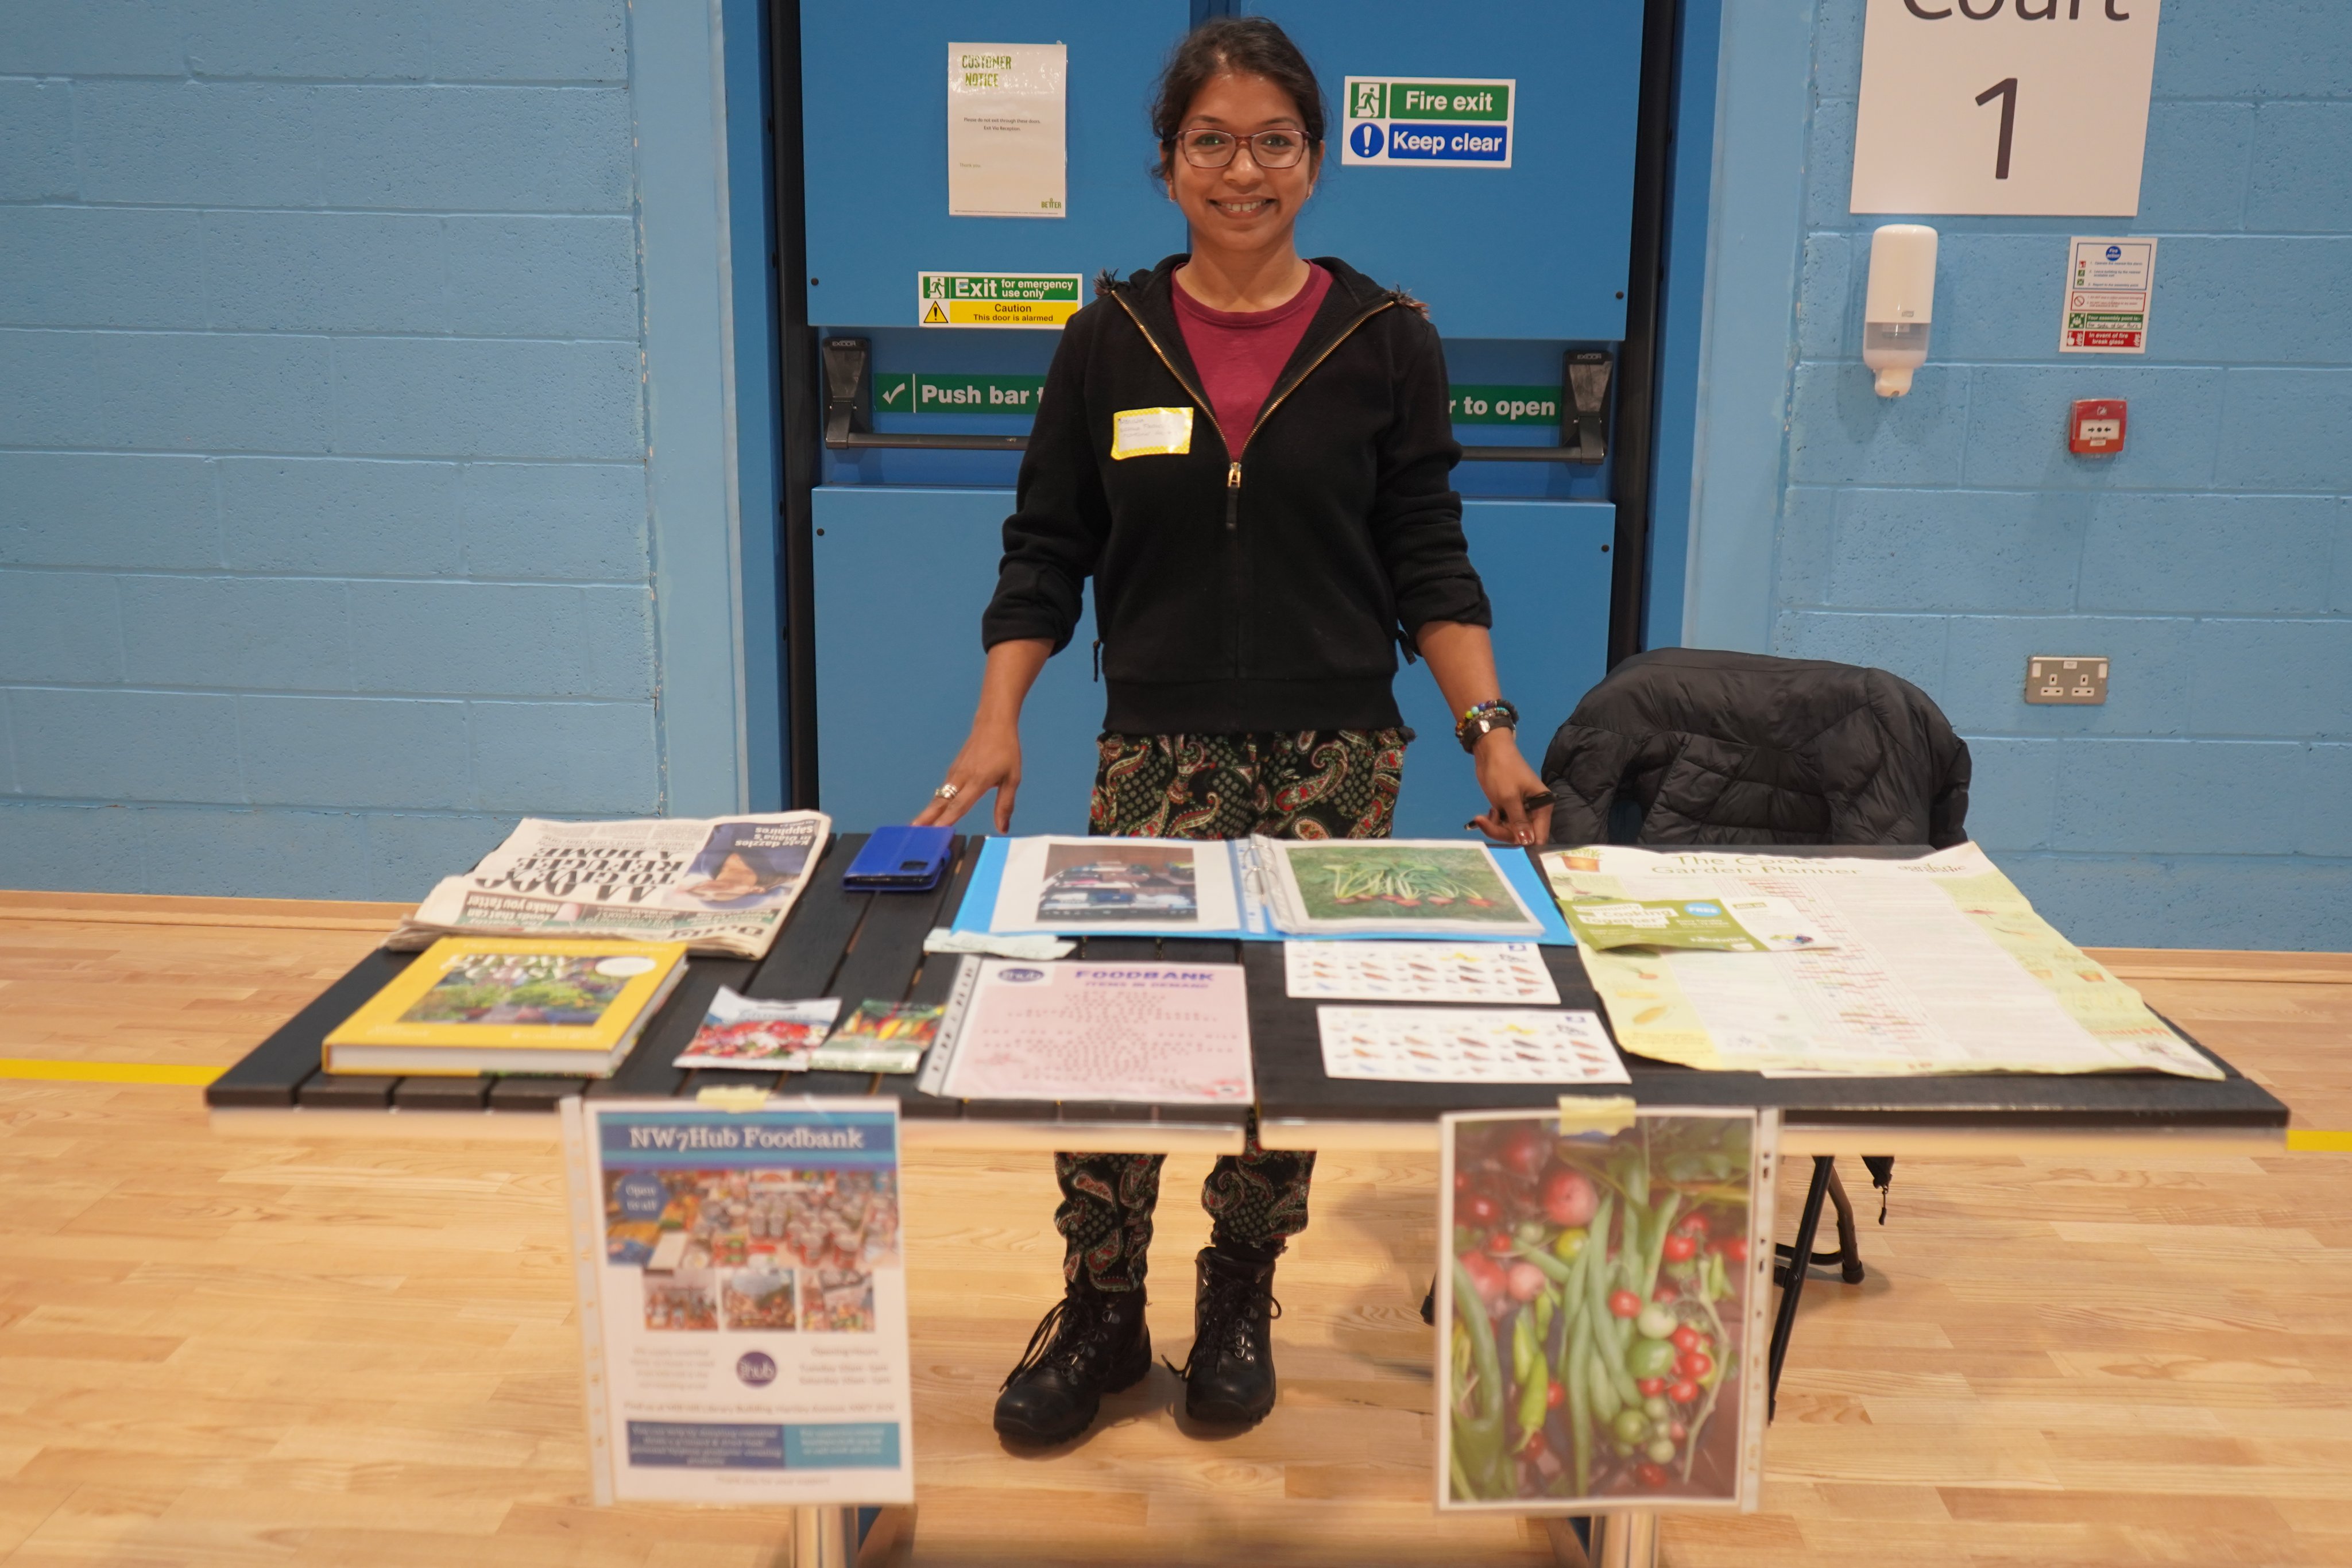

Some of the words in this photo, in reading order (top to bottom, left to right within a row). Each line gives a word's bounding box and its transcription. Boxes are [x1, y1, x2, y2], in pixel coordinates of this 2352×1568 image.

[962, 55, 1012, 69] CUSTOMER
[965, 73, 999, 87] NOTICE
[1406, 91, 1448, 110] Fire
[1453, 92, 1493, 111] exit
[1975, 78, 2018, 179] 1
[1394, 131, 1445, 155] Keep
[1451, 133, 1503, 152] clear
[956, 278, 997, 297] Exit
[1001, 279, 1015, 287] for
[1018, 281, 1073, 291] emergency
[1023, 289, 1044, 299] only
[995, 304, 1031, 312] Caution
[922, 385, 981, 404] Push
[989, 385, 1030, 404] bar
[1464, 396, 1488, 415] to
[1495, 400, 1555, 420] open
[734, 839, 780, 848] dazzles
[753, 834, 798, 842] Diana's
[531, 848, 647, 859] HOME
[1672, 855, 1725, 865] The
[1735, 857, 1828, 865] Cook's
[510, 858, 684, 873] REFUGEE
[1761, 866, 1863, 874] Planner
[535, 870, 620, 884] GIVE
[627, 873, 675, 885] TO
[467, 896, 503, 911] fatter
[503, 899, 527, 911] you
[525, 901, 560, 914] make
[467, 908, 489, 917] can
[488, 911, 516, 920] that
[1074, 970, 1213, 981] FOODBANK
[628, 1128, 739, 1151] NW7Hub
[744, 1127, 864, 1148] Foodbank
[625, 1184, 657, 1198] Open
